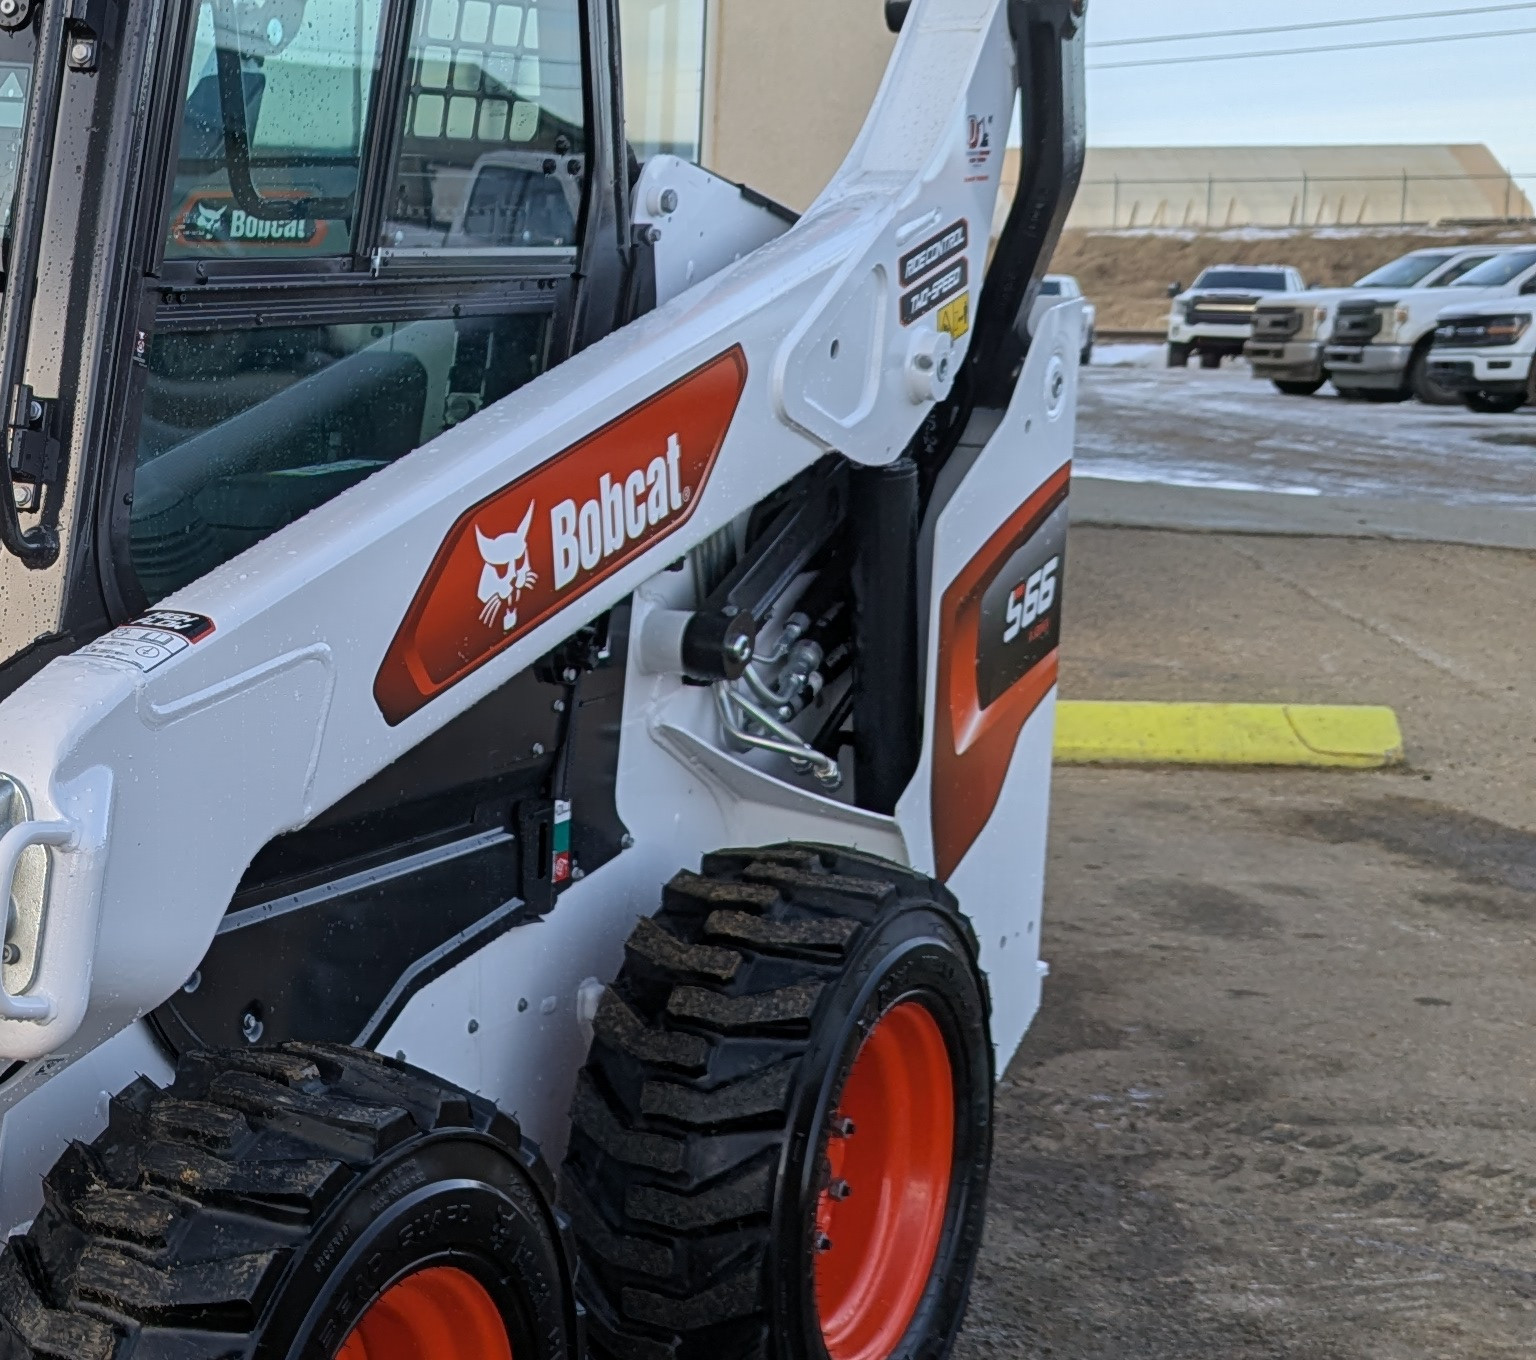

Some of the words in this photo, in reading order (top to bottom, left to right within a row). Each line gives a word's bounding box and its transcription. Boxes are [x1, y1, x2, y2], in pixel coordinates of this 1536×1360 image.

[230, 209, 306, 239] Bobcat
[550, 432, 683, 591] Bobcat
[1003, 556, 1059, 643] S66
